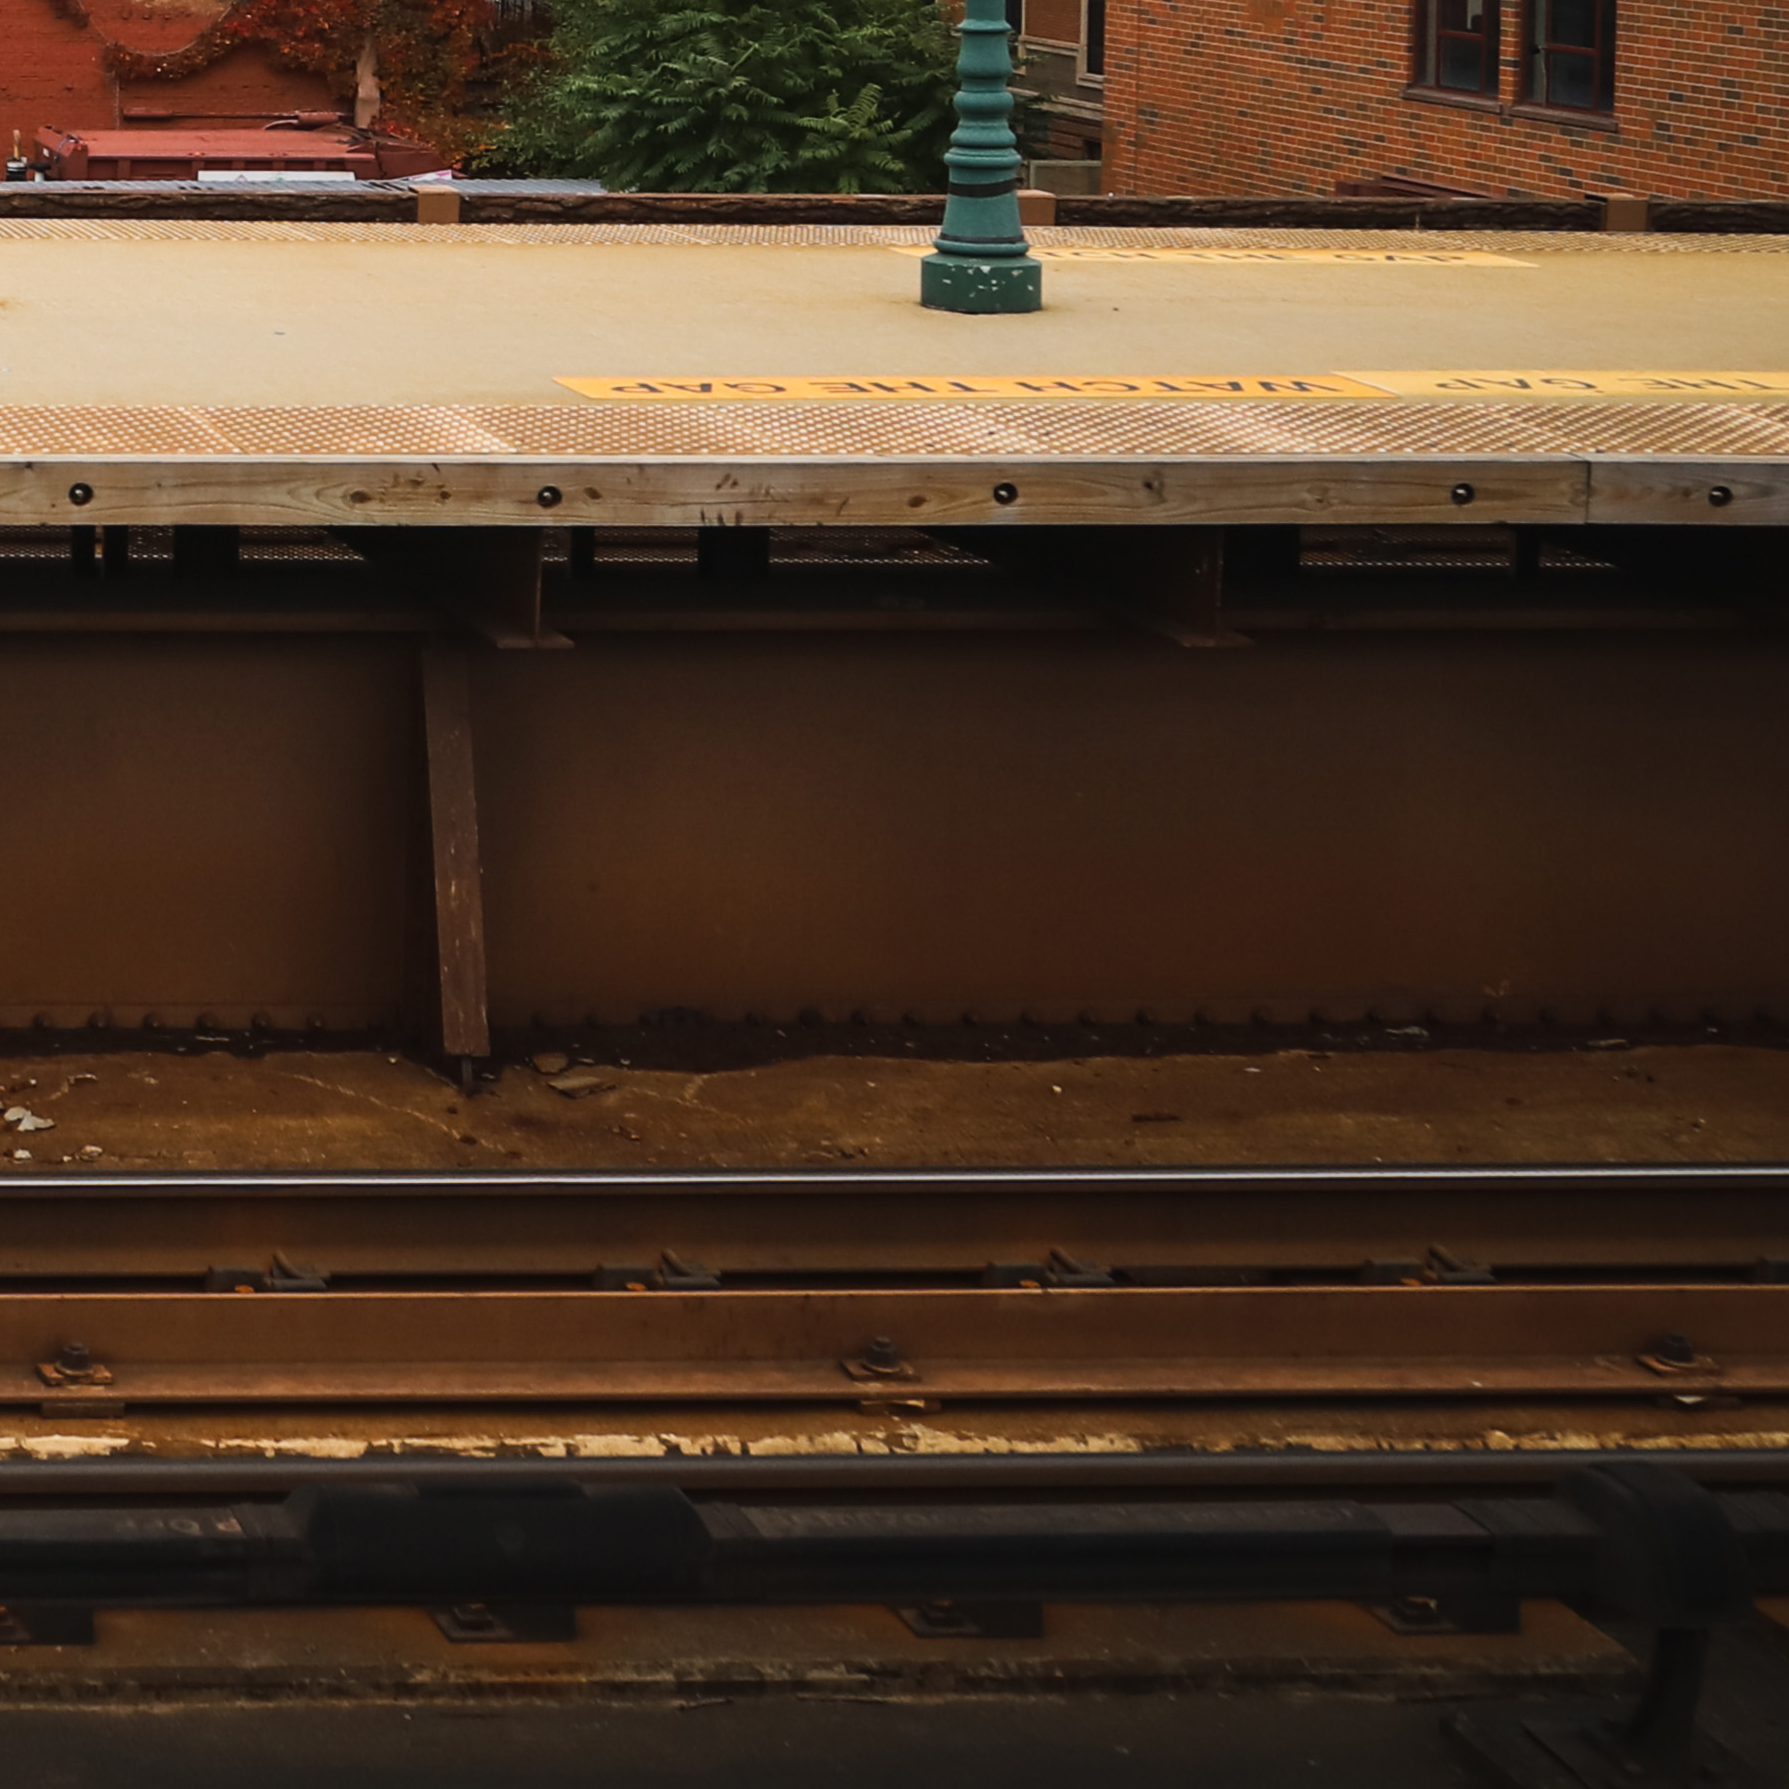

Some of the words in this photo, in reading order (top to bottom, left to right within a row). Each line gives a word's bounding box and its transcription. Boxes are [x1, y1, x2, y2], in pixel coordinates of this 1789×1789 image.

[609, 381, 788, 395] GAP
[807, 381, 1000, 394] THE
[1013, 379, 1346, 394] WATCH
[1434, 377, 1600, 392] GAP
